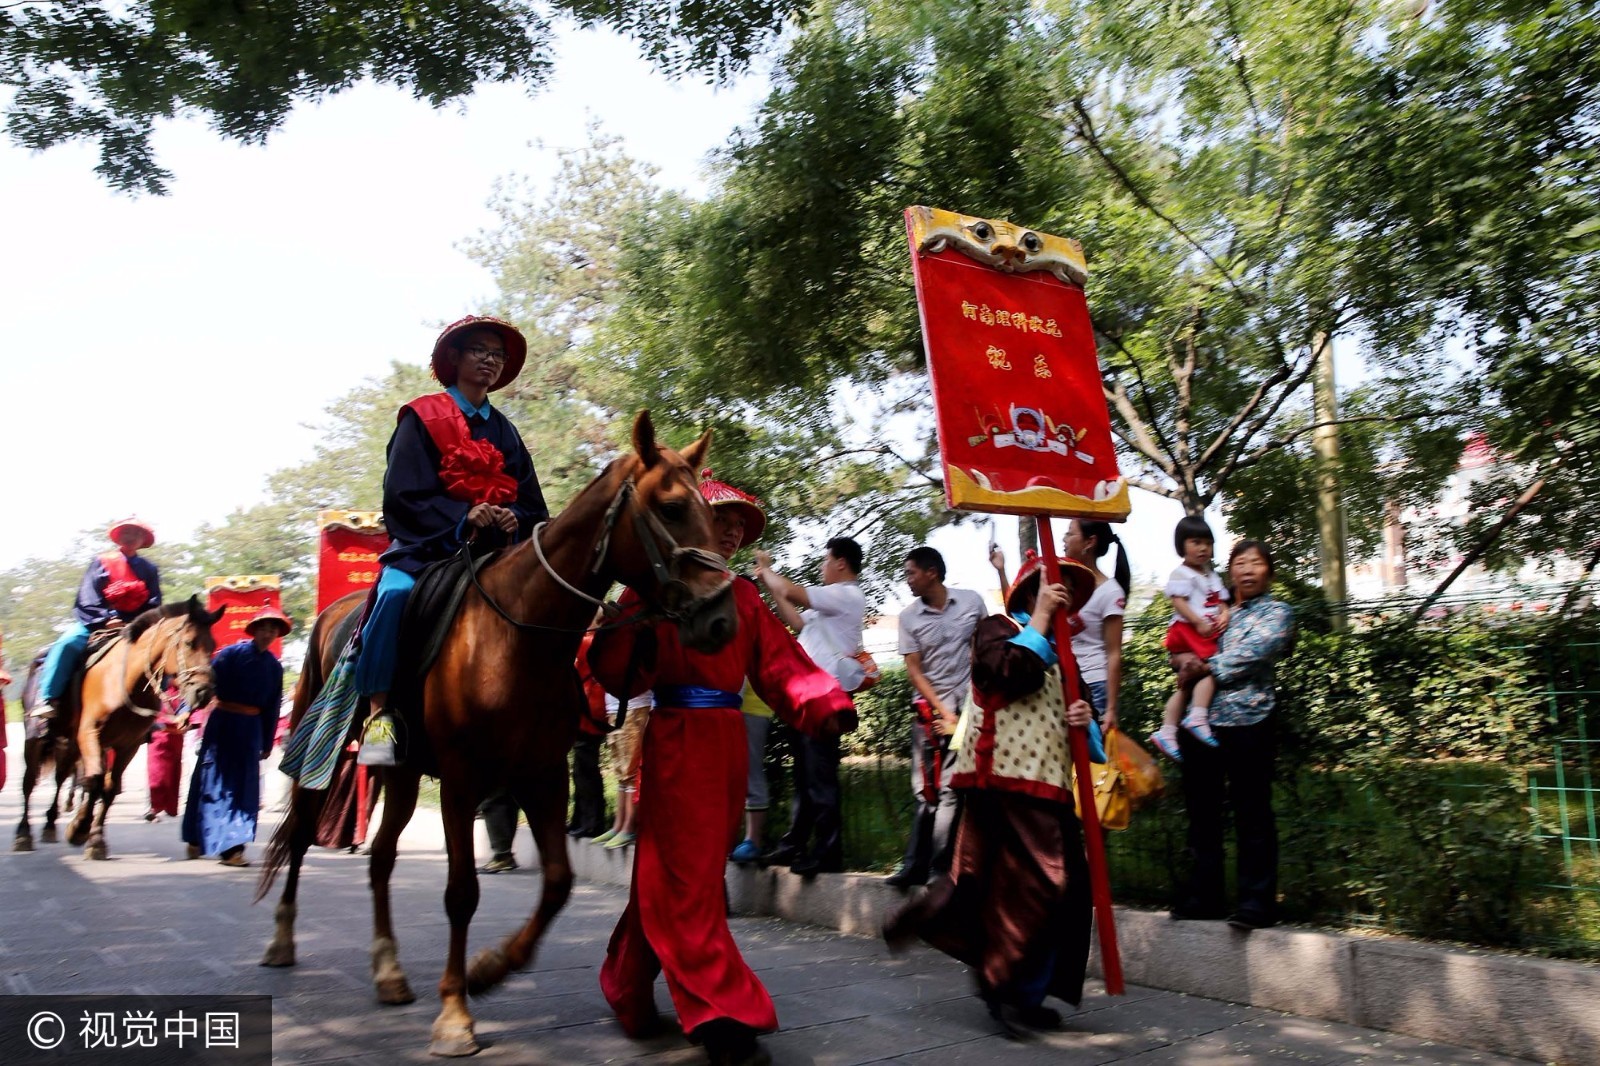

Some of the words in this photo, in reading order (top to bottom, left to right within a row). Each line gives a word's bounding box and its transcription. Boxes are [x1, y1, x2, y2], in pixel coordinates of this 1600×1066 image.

[962, 301, 1063, 338] 河南理科状元
